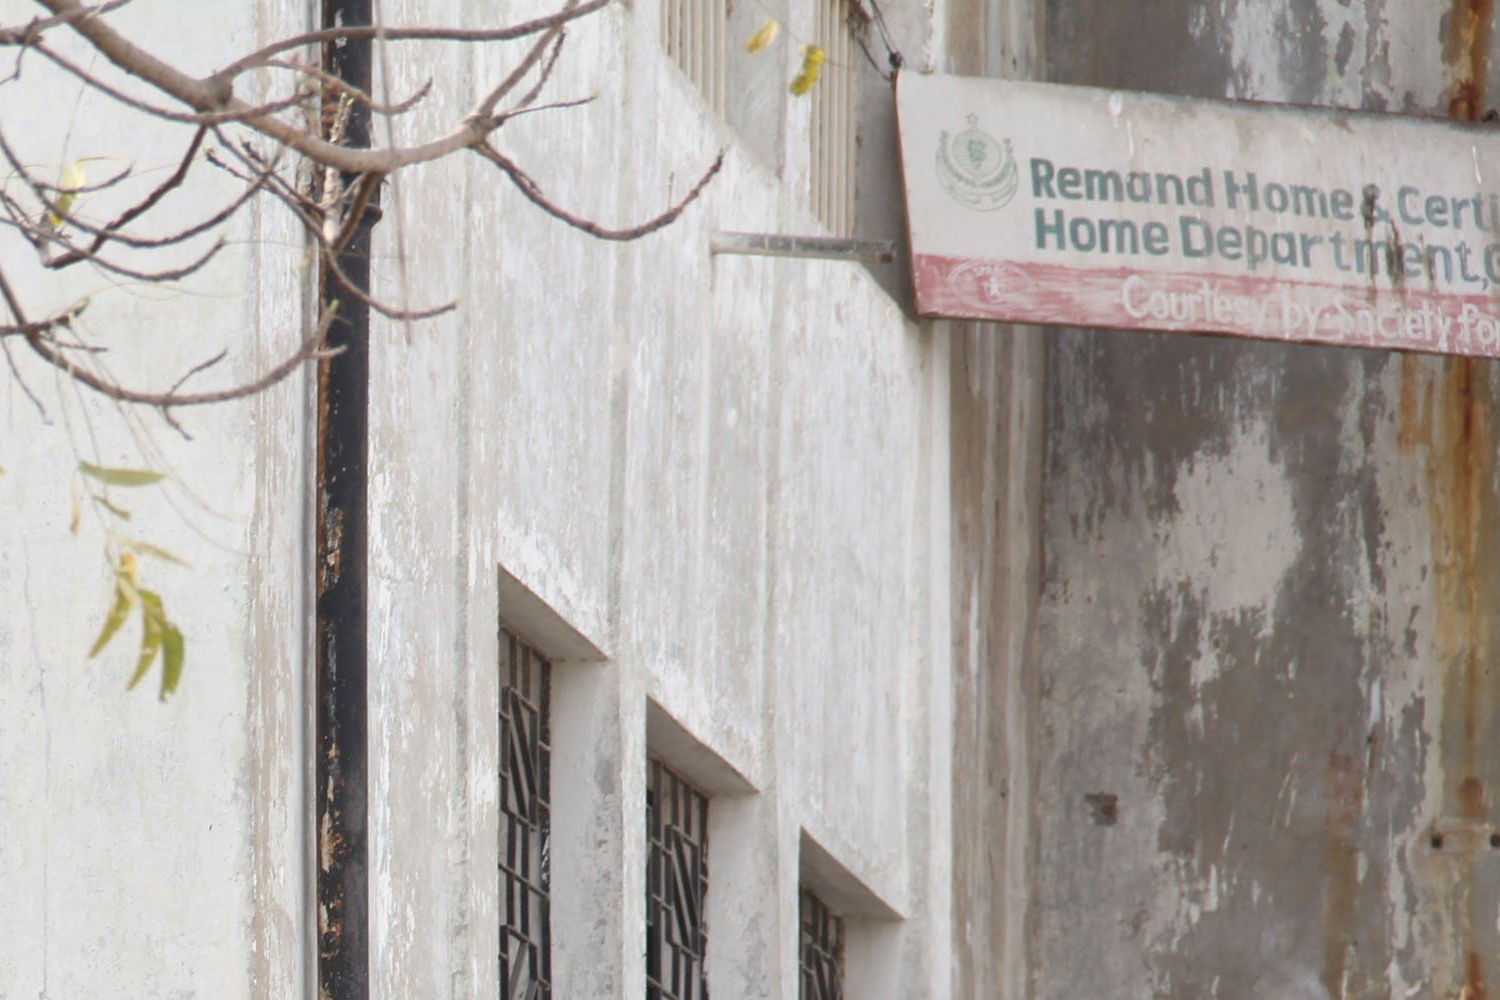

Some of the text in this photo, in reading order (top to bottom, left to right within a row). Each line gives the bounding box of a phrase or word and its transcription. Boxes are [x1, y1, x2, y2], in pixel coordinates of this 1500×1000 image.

[1029, 157, 1215, 208] Remand
[1223, 169, 1356, 223] Home
[1359, 183, 1391, 226] &
[1033, 207, 1170, 257] Home
[1122, 274, 1268, 332] Courtesy
[1281, 282, 1324, 338] by
